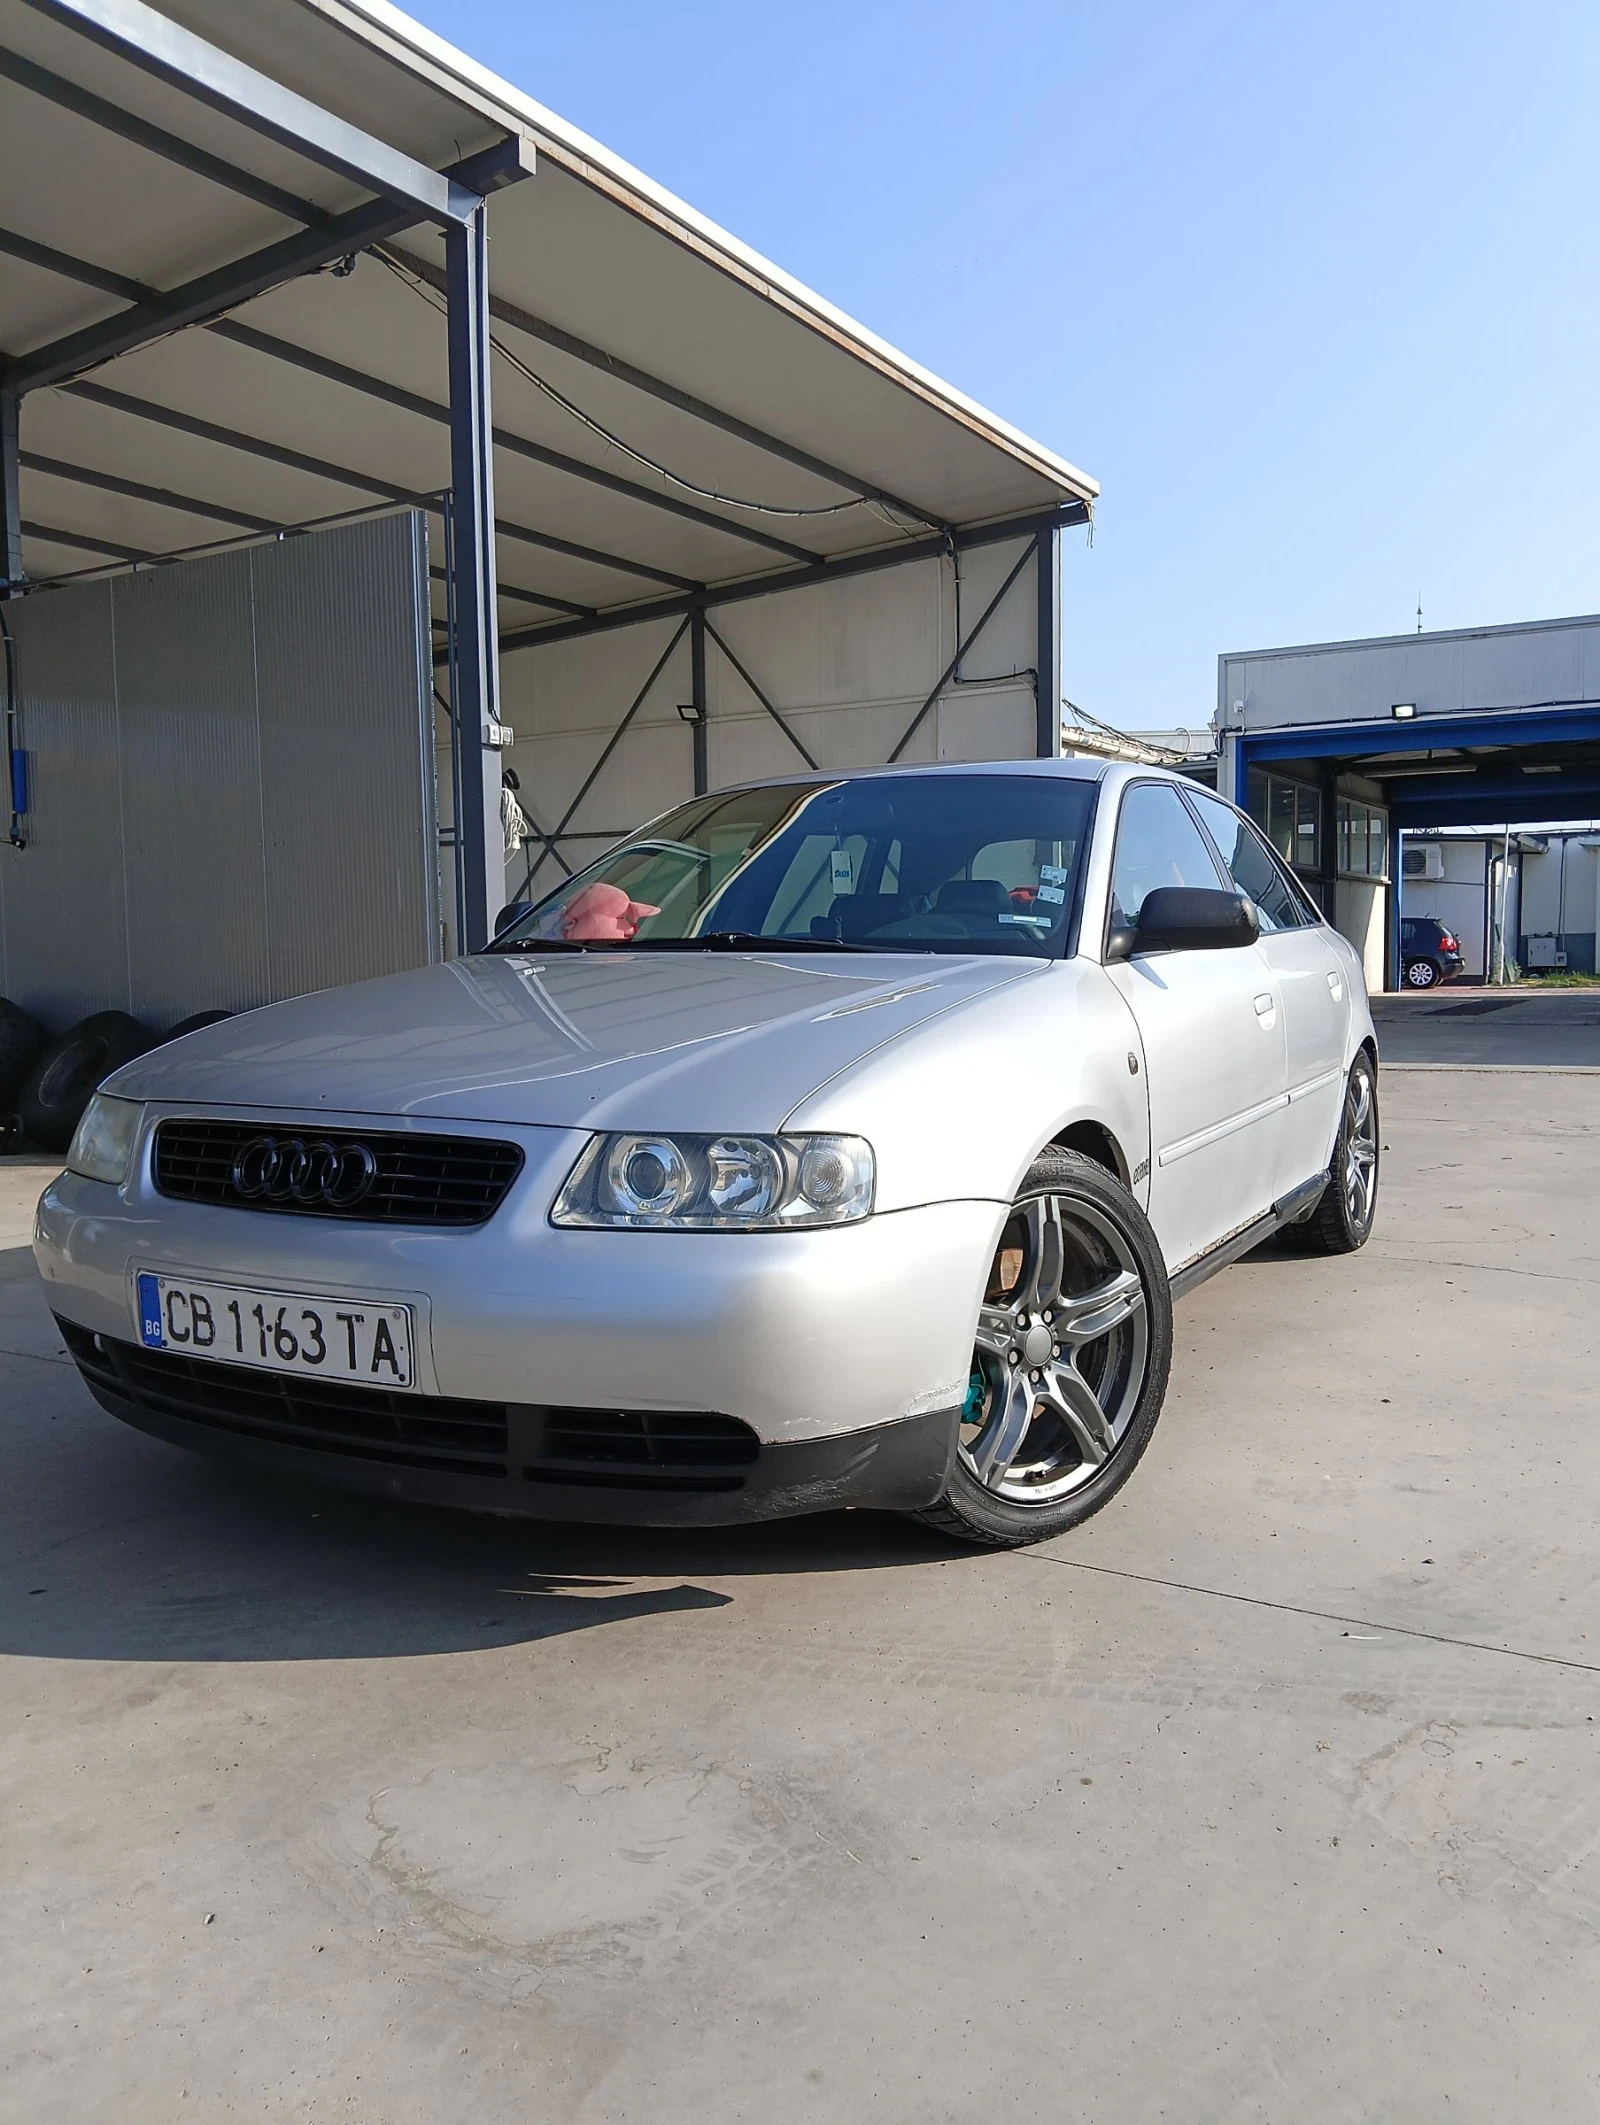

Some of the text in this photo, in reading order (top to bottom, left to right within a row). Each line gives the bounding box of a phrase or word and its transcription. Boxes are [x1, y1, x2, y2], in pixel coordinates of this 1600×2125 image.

[145, 1319, 160, 1337] BG
[166, 1290, 400, 1375] CB 1163 TA
